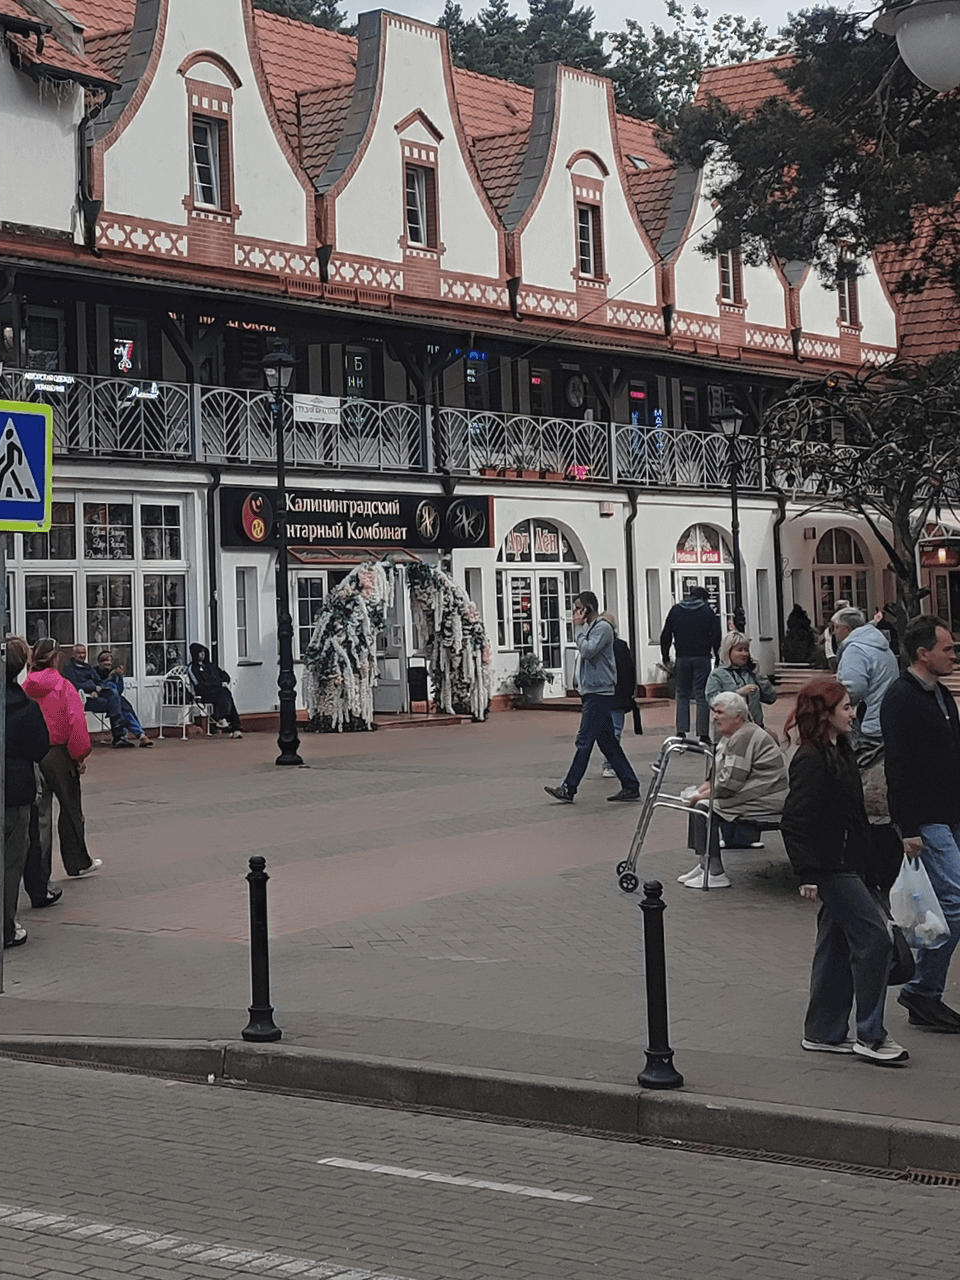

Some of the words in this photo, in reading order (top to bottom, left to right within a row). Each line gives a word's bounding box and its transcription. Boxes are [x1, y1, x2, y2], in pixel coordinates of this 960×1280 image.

[284, 492, 400, 518] Калининградский
[277, 521, 344, 543] нтарный
[347, 521, 408, 541] Комбинат
[506, 529, 530, 561] Арт
[535, 528, 559, 554] Лён
